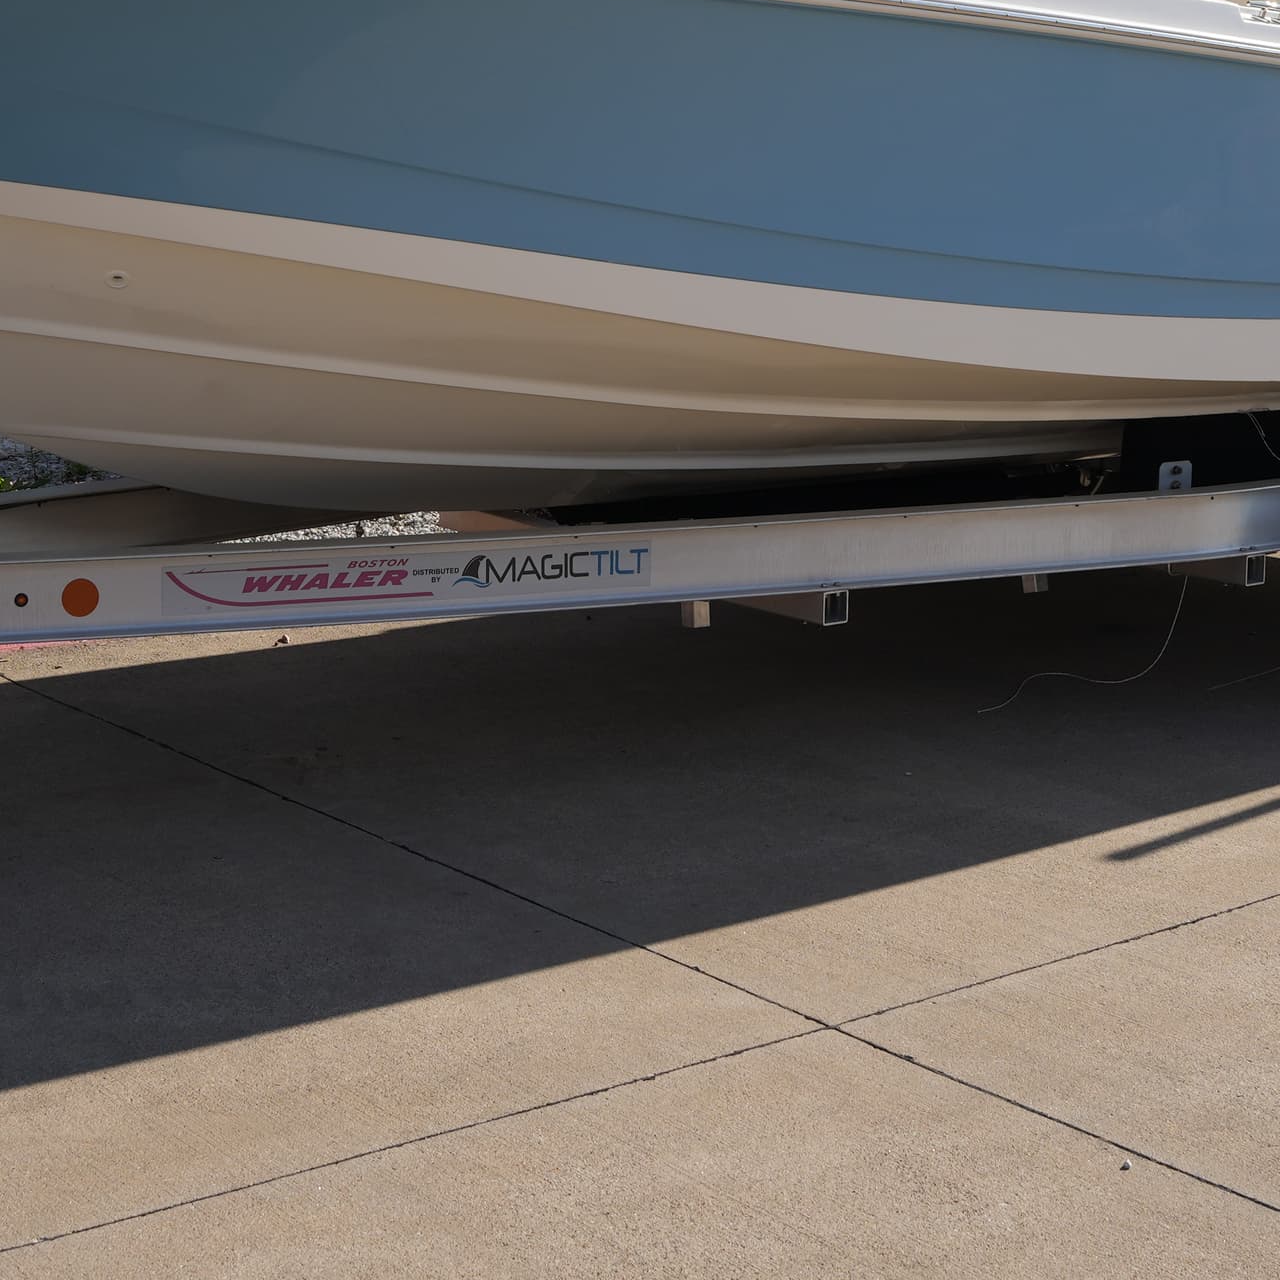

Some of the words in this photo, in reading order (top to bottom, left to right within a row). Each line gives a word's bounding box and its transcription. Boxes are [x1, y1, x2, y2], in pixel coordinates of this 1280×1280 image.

[347, 558, 409, 569] BOSTON
[412, 567, 460, 577] DISTRIBUTED
[485, 548, 649, 584] MAGICTILT
[242, 570, 409, 594] WHALER
